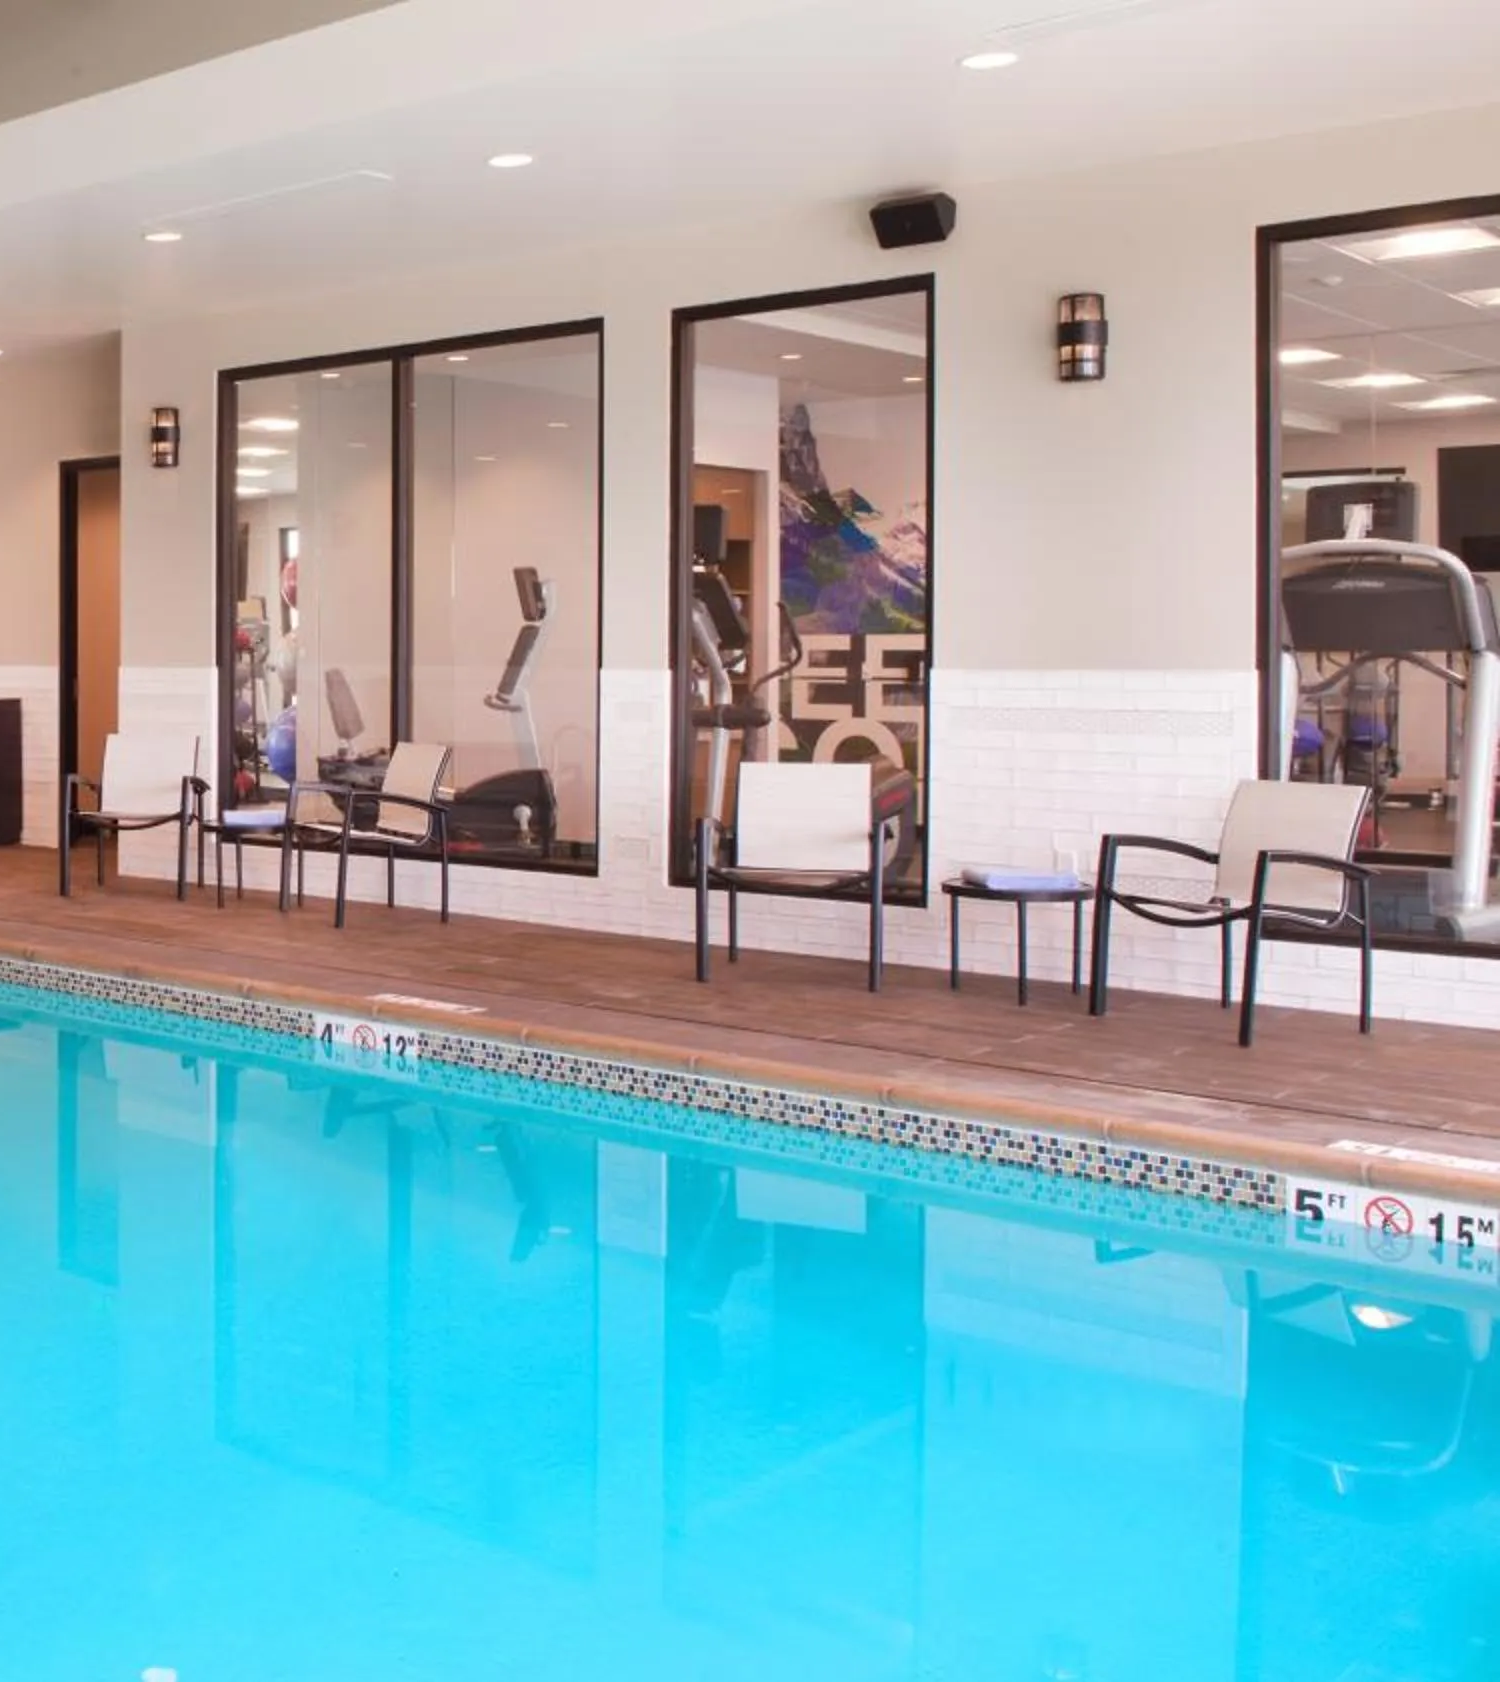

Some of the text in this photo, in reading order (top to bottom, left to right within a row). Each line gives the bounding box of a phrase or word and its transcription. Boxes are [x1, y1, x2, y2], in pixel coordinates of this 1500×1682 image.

[1295, 1188, 1324, 1221] 5
[1327, 1193, 1347, 1209] FT
[1477, 1218, 1494, 1234] M
